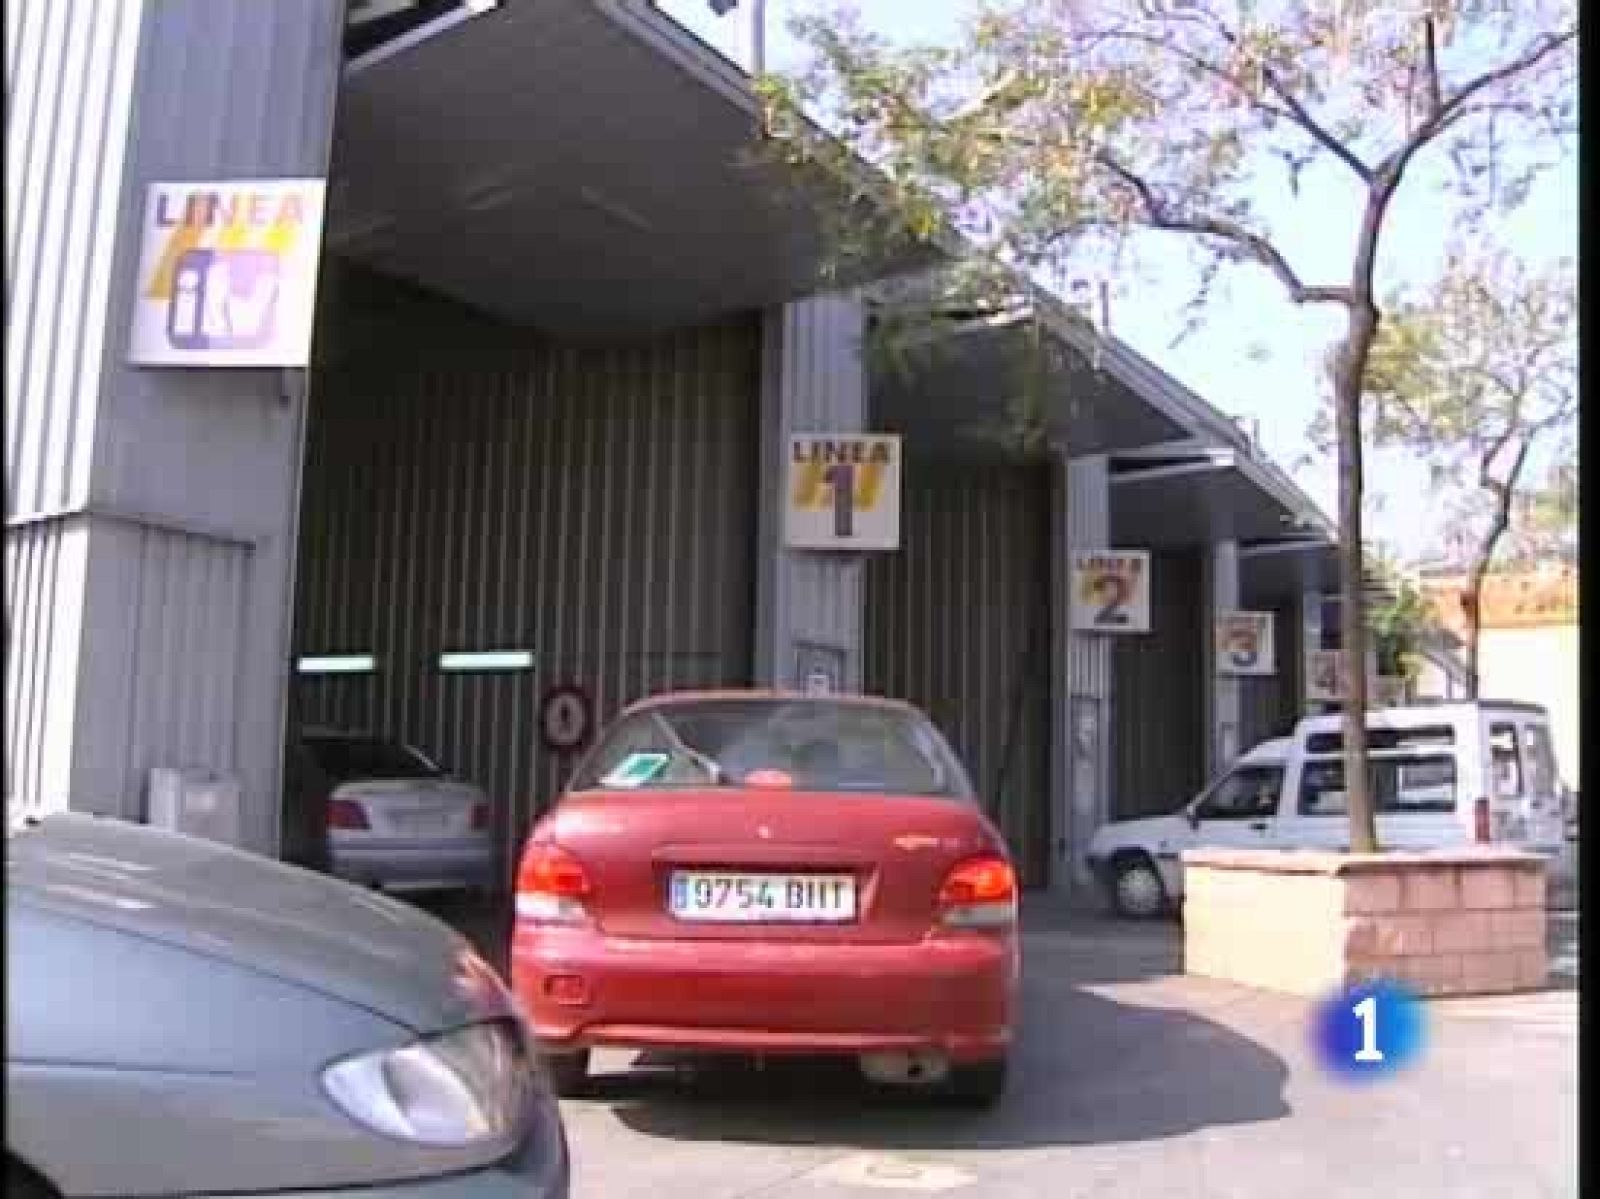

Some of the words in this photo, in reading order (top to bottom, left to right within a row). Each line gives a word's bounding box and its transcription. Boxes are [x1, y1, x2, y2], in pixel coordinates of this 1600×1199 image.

[156, 190, 304, 228] LINEA
[793, 440, 890, 465] LINEA
[823, 465, 853, 538] 1
[1094, 575, 1130, 625] 2
